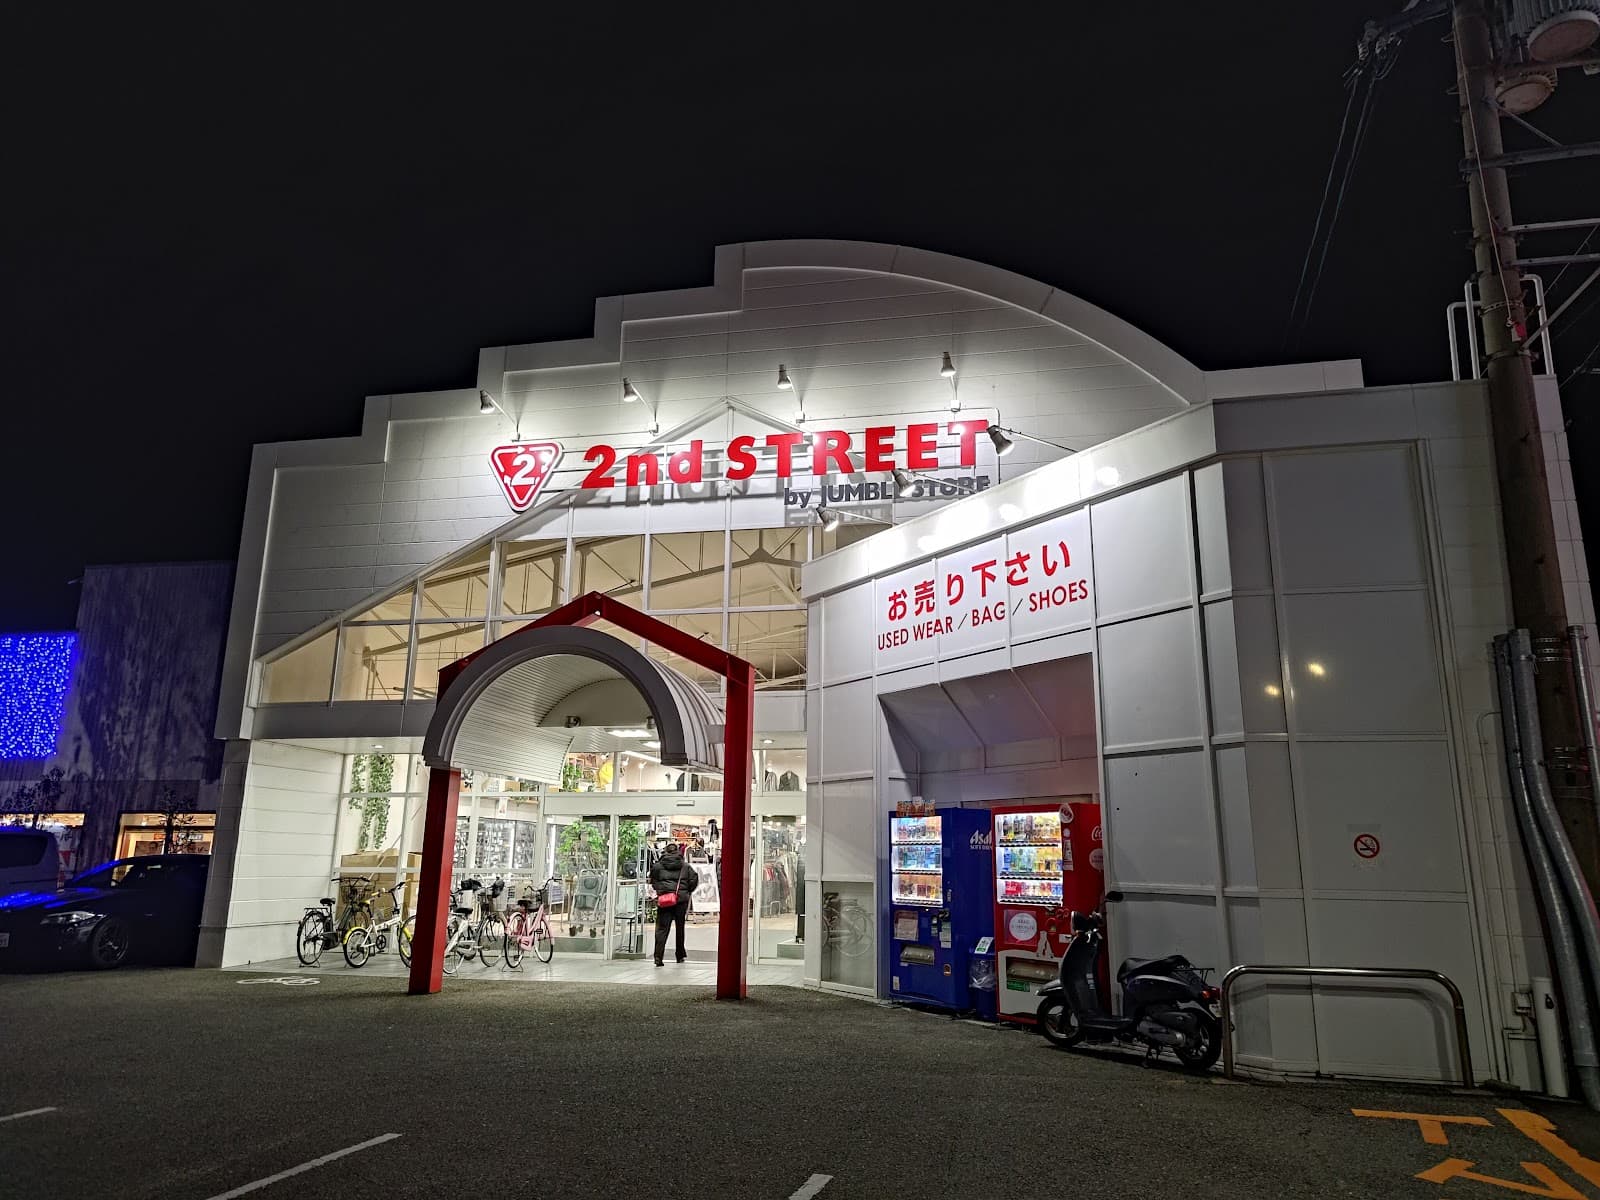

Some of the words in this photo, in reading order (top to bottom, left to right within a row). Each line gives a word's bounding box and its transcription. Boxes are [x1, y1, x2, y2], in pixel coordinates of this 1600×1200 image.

[580, 440, 703, 489] 2nd
[726, 419, 988, 480] STREET
[784, 488, 812, 508] by
[877, 628, 909, 651] USED
[913, 616, 953, 641] WEAR
[972, 601, 1006, 627] BAG
[1029, 579, 1088, 613] SHOES
[888, 541, 1071, 621] お売り下さい
